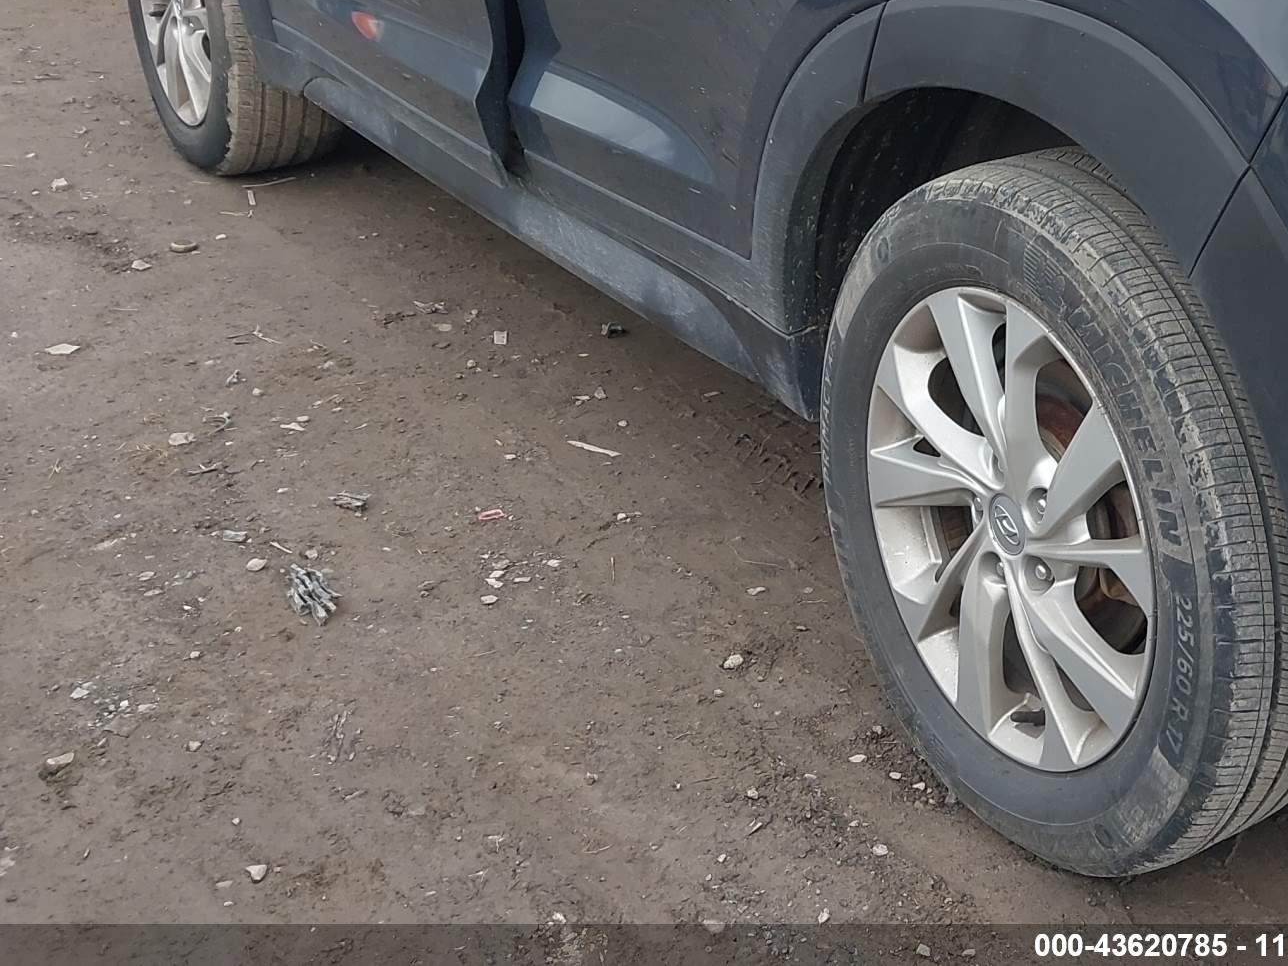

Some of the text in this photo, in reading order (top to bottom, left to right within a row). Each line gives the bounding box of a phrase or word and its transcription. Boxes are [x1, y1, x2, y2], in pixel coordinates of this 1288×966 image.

[820, 368, 833, 485] PRIMACY
[1066, 306, 1184, 547] MICHELIN
[1165, 594, 1195, 755] 225/60 R 17
